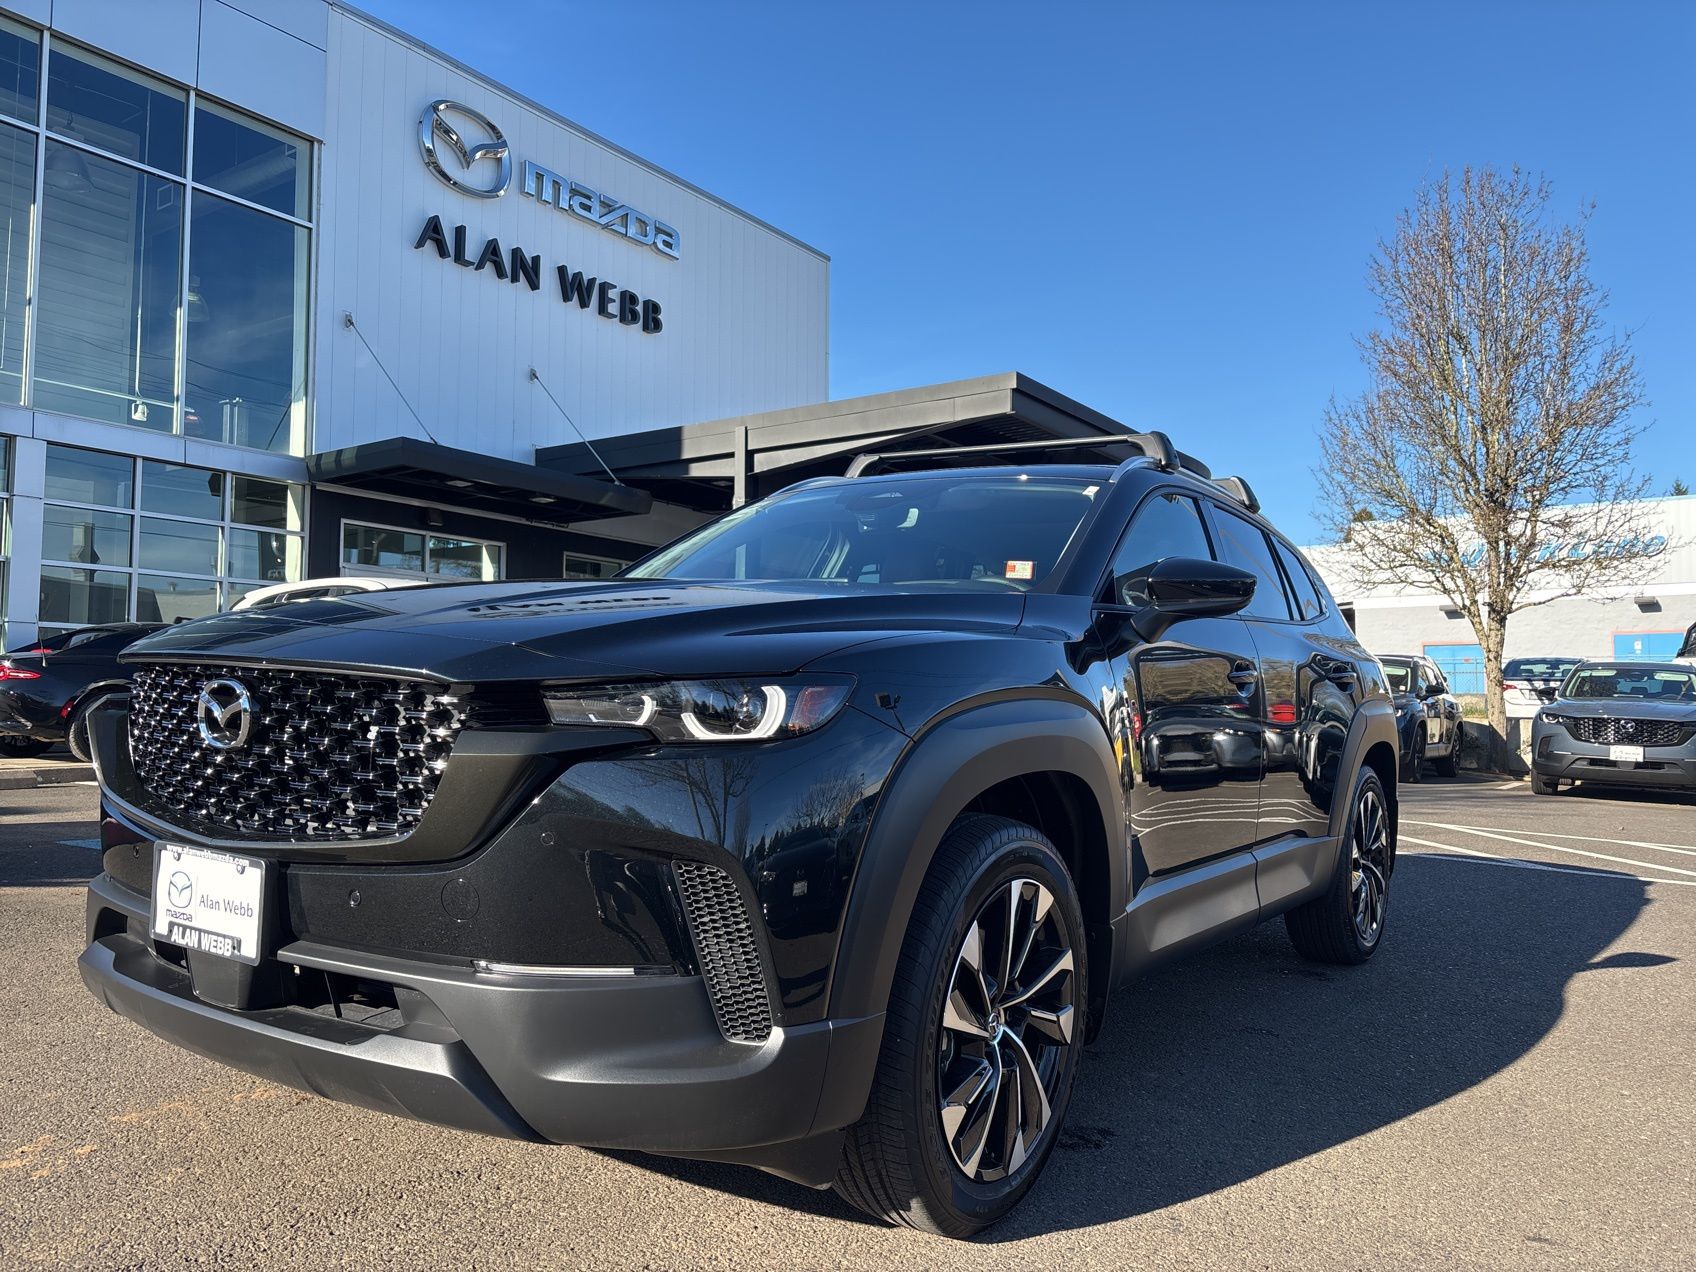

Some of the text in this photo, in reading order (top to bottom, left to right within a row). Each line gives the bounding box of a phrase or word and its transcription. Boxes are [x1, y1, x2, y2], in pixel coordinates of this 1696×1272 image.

[414, 215, 663, 334] ALAN WEBB
[199, 894, 253, 918] Alan Webb
[171, 925, 232, 957] ALAN WEBB
